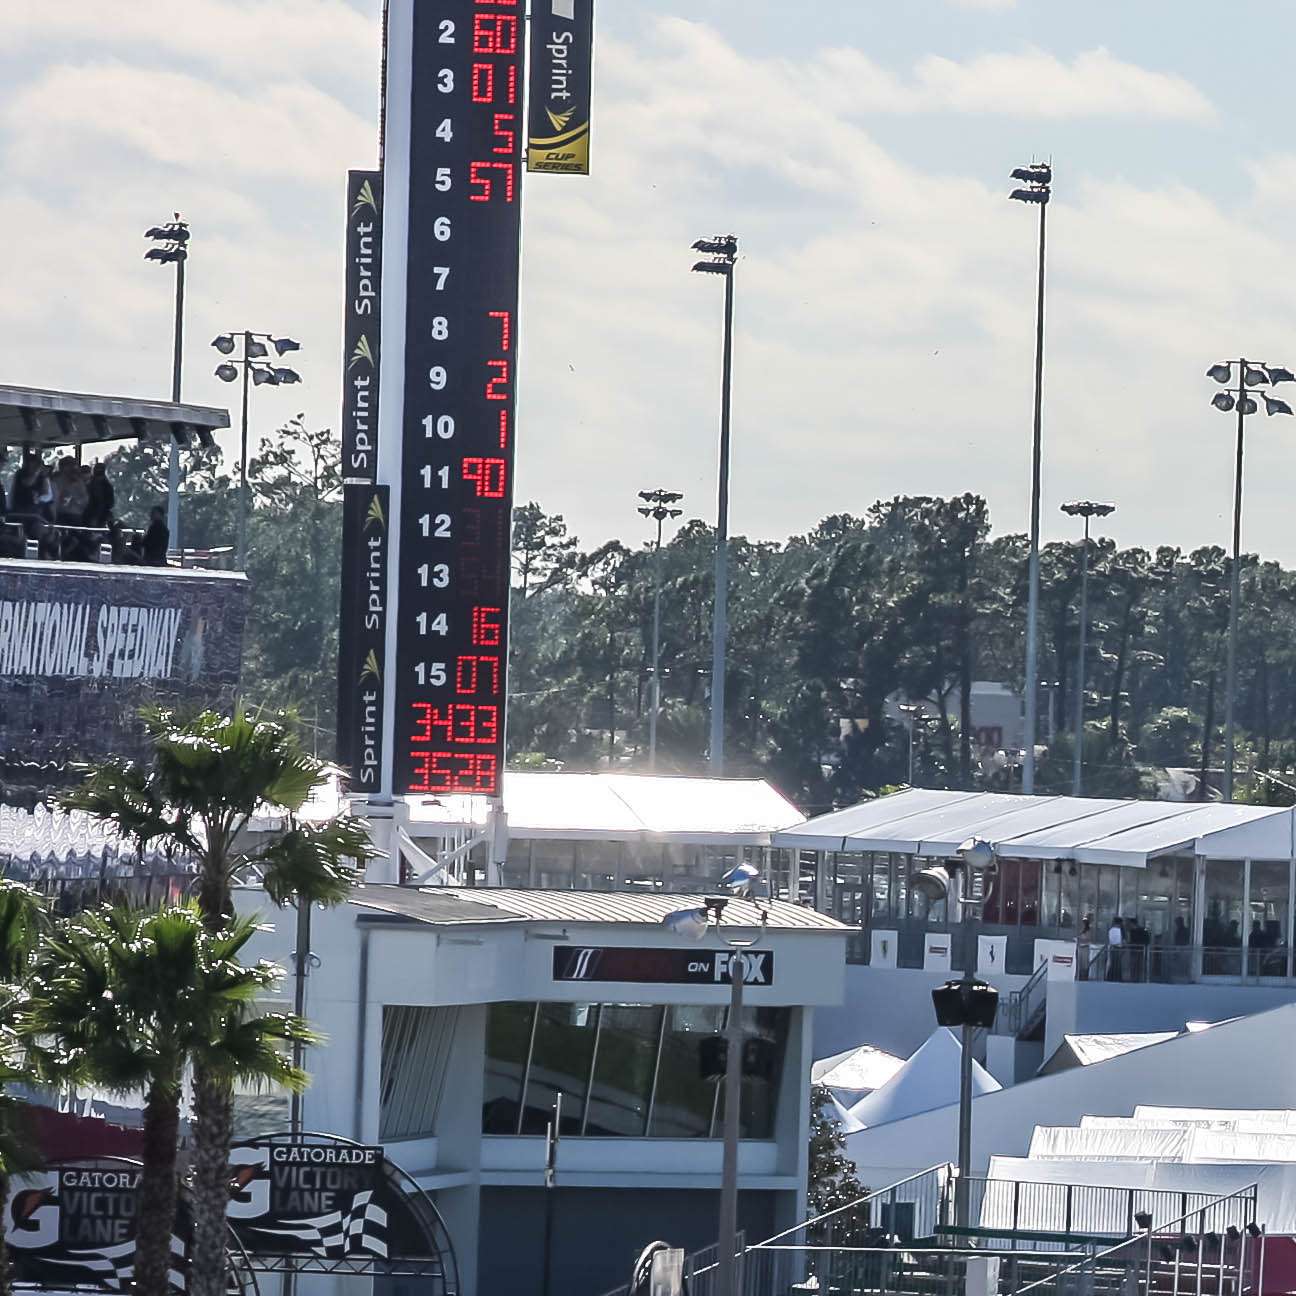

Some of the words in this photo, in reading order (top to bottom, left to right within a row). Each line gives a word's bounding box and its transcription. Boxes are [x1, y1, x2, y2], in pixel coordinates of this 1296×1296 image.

[438, 20, 456, 44] 2
[546, 31, 573, 100] Sprint
[437, 68, 454, 93] 3
[435, 118, 454, 142] 4
[492, 113, 515, 154] 5
[533, 162, 583, 171] SERIES
[545, 152, 577, 161] CUP
[434, 167, 452, 192] 5
[434, 217, 451, 241] 6
[355, 221, 374, 315] Sprint
[433, 266, 450, 291] 7
[431, 316, 449, 340] 8
[429, 366, 447, 390] 9
[352, 375, 371, 468] Sprint
[421, 415, 455, 439] 10
[420, 465, 450, 489] 11
[418, 514, 452, 537] 12
[365, 536, 382, 632] Sprint
[417, 564, 450, 588] 13
[416, 612, 449, 636] 14
[91, 604, 182, 678] SPEEDWAY
[414, 662, 447, 686] 15
[361, 689, 378, 784] Sprint
[687, 961, 710, 973] ON
[273, 1149, 376, 1164] GATORADE
[274, 1166, 374, 1190] VICTORY
[275, 1192, 337, 1213] LANE
[64, 1219, 130, 1243] LANE
